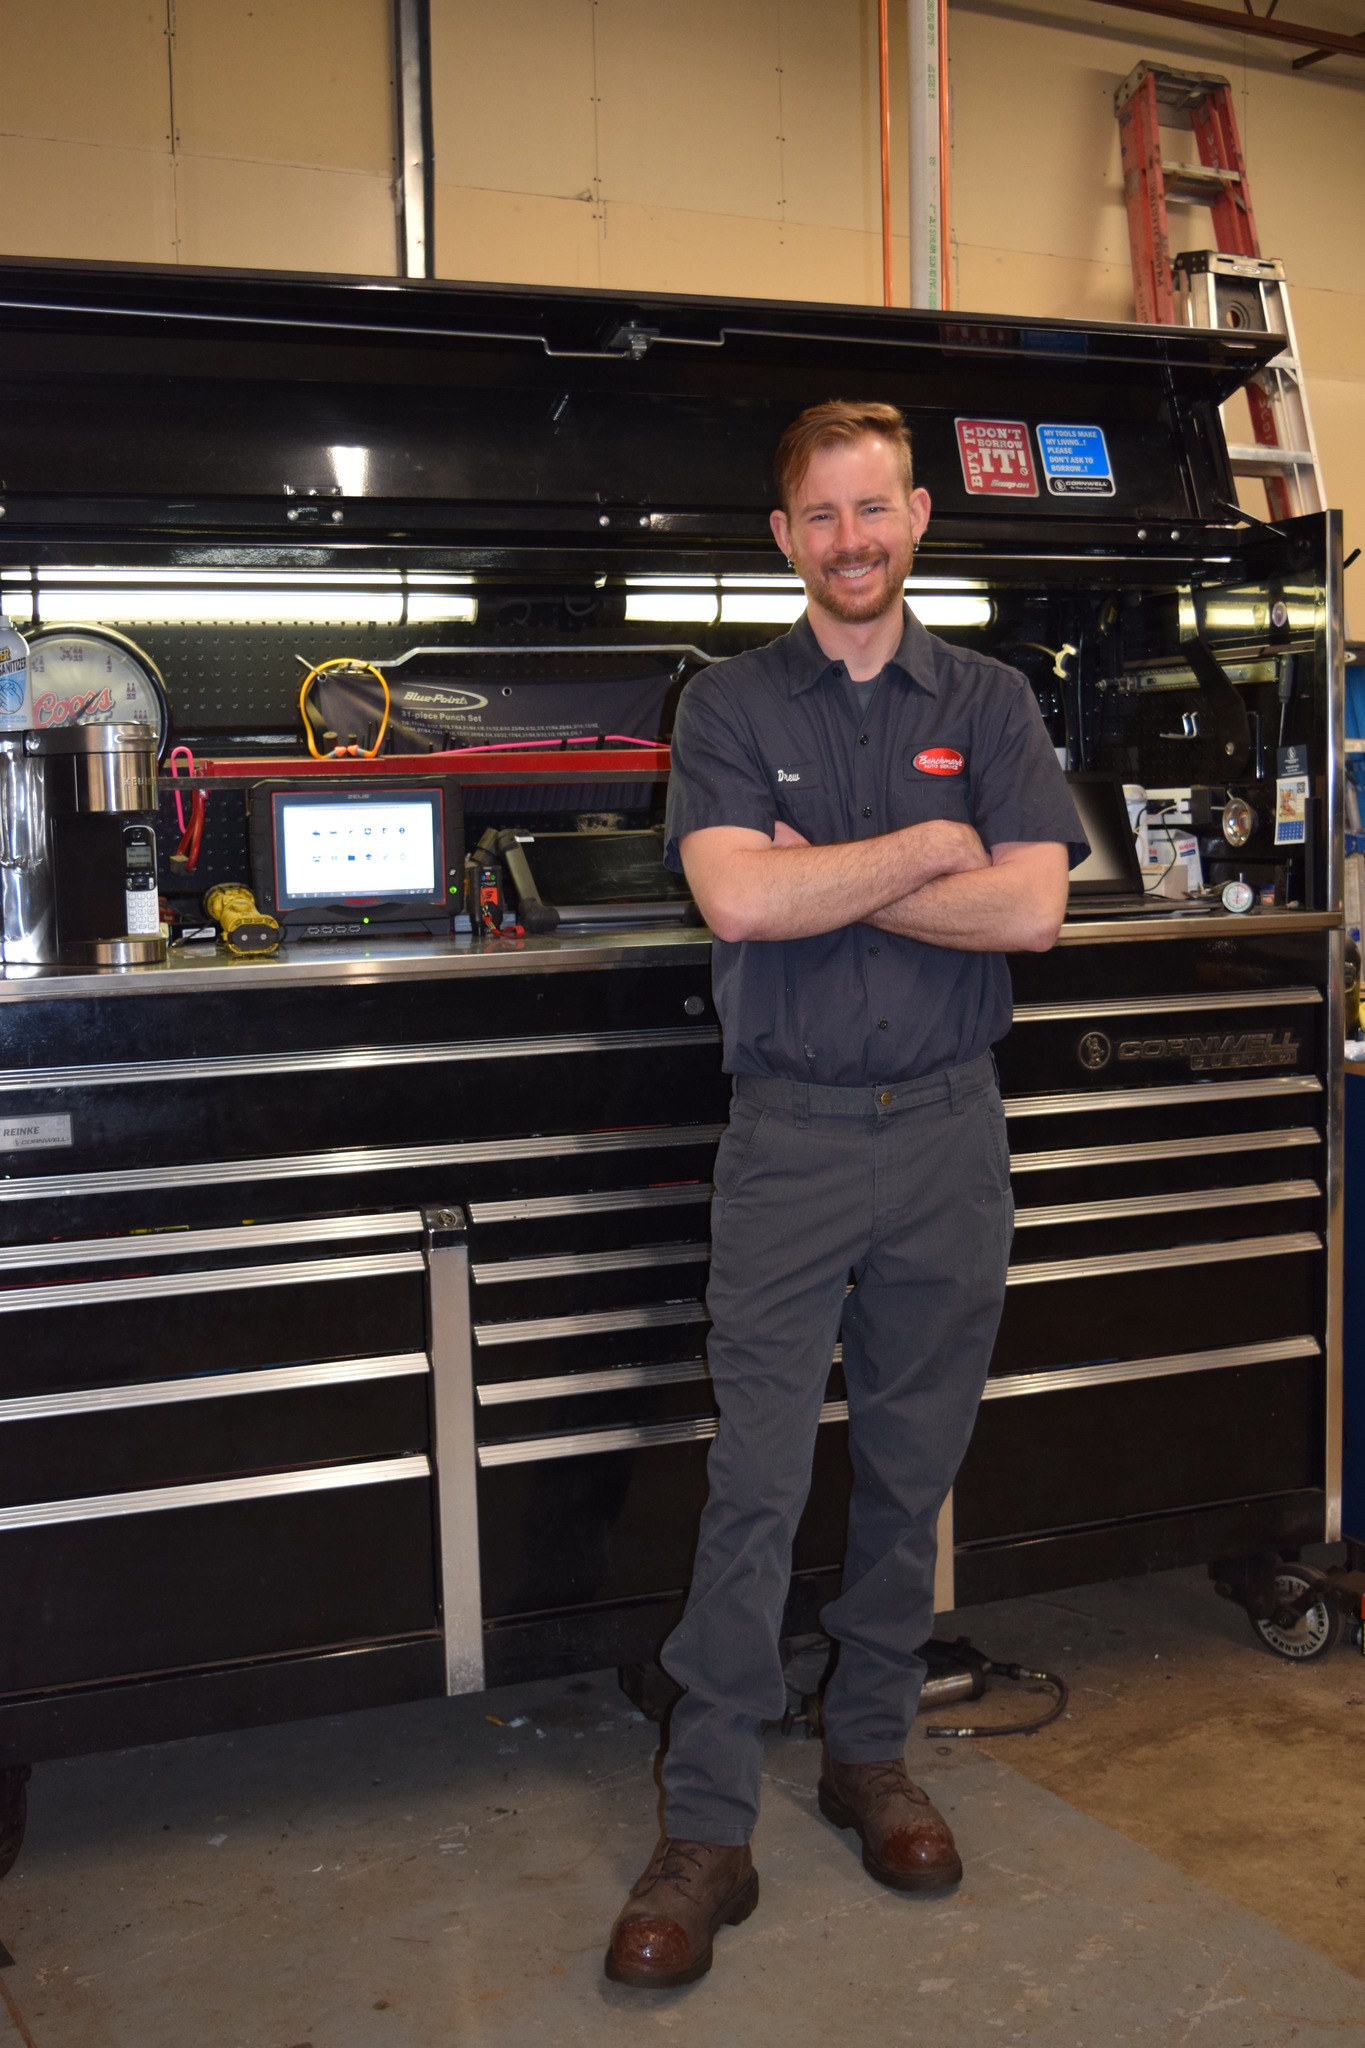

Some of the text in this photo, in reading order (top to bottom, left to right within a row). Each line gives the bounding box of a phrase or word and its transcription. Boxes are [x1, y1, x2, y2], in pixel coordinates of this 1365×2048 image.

[975, 426, 1022, 440] DON'T
[1043, 429, 1098, 438] MY TOOLS MAKE
[977, 438, 1023, 450] BORROW
[962, 426, 983, 488] BUY IT
[1047, 447, 1073, 455] PLEASE
[979, 448, 1029, 476] IT!
[1049, 456, 1069, 464] DON'T
[990, 479, 1030, 489] Snap-on
[32, 687, 114, 729] Coors
[439, 713, 466, 722] Punch
[467, 714, 482, 723] Set
[918, 755, 963, 767] Benchmark
[777, 769, 800, 782] Drew
[1118, 1032, 1300, 1060] CORNWELL
[3, 1126, 40, 1137] REINKE
[21, 1137, 68, 1145] CORNWELL
[1266, 1630, 1317, 1654] CORNWELL
